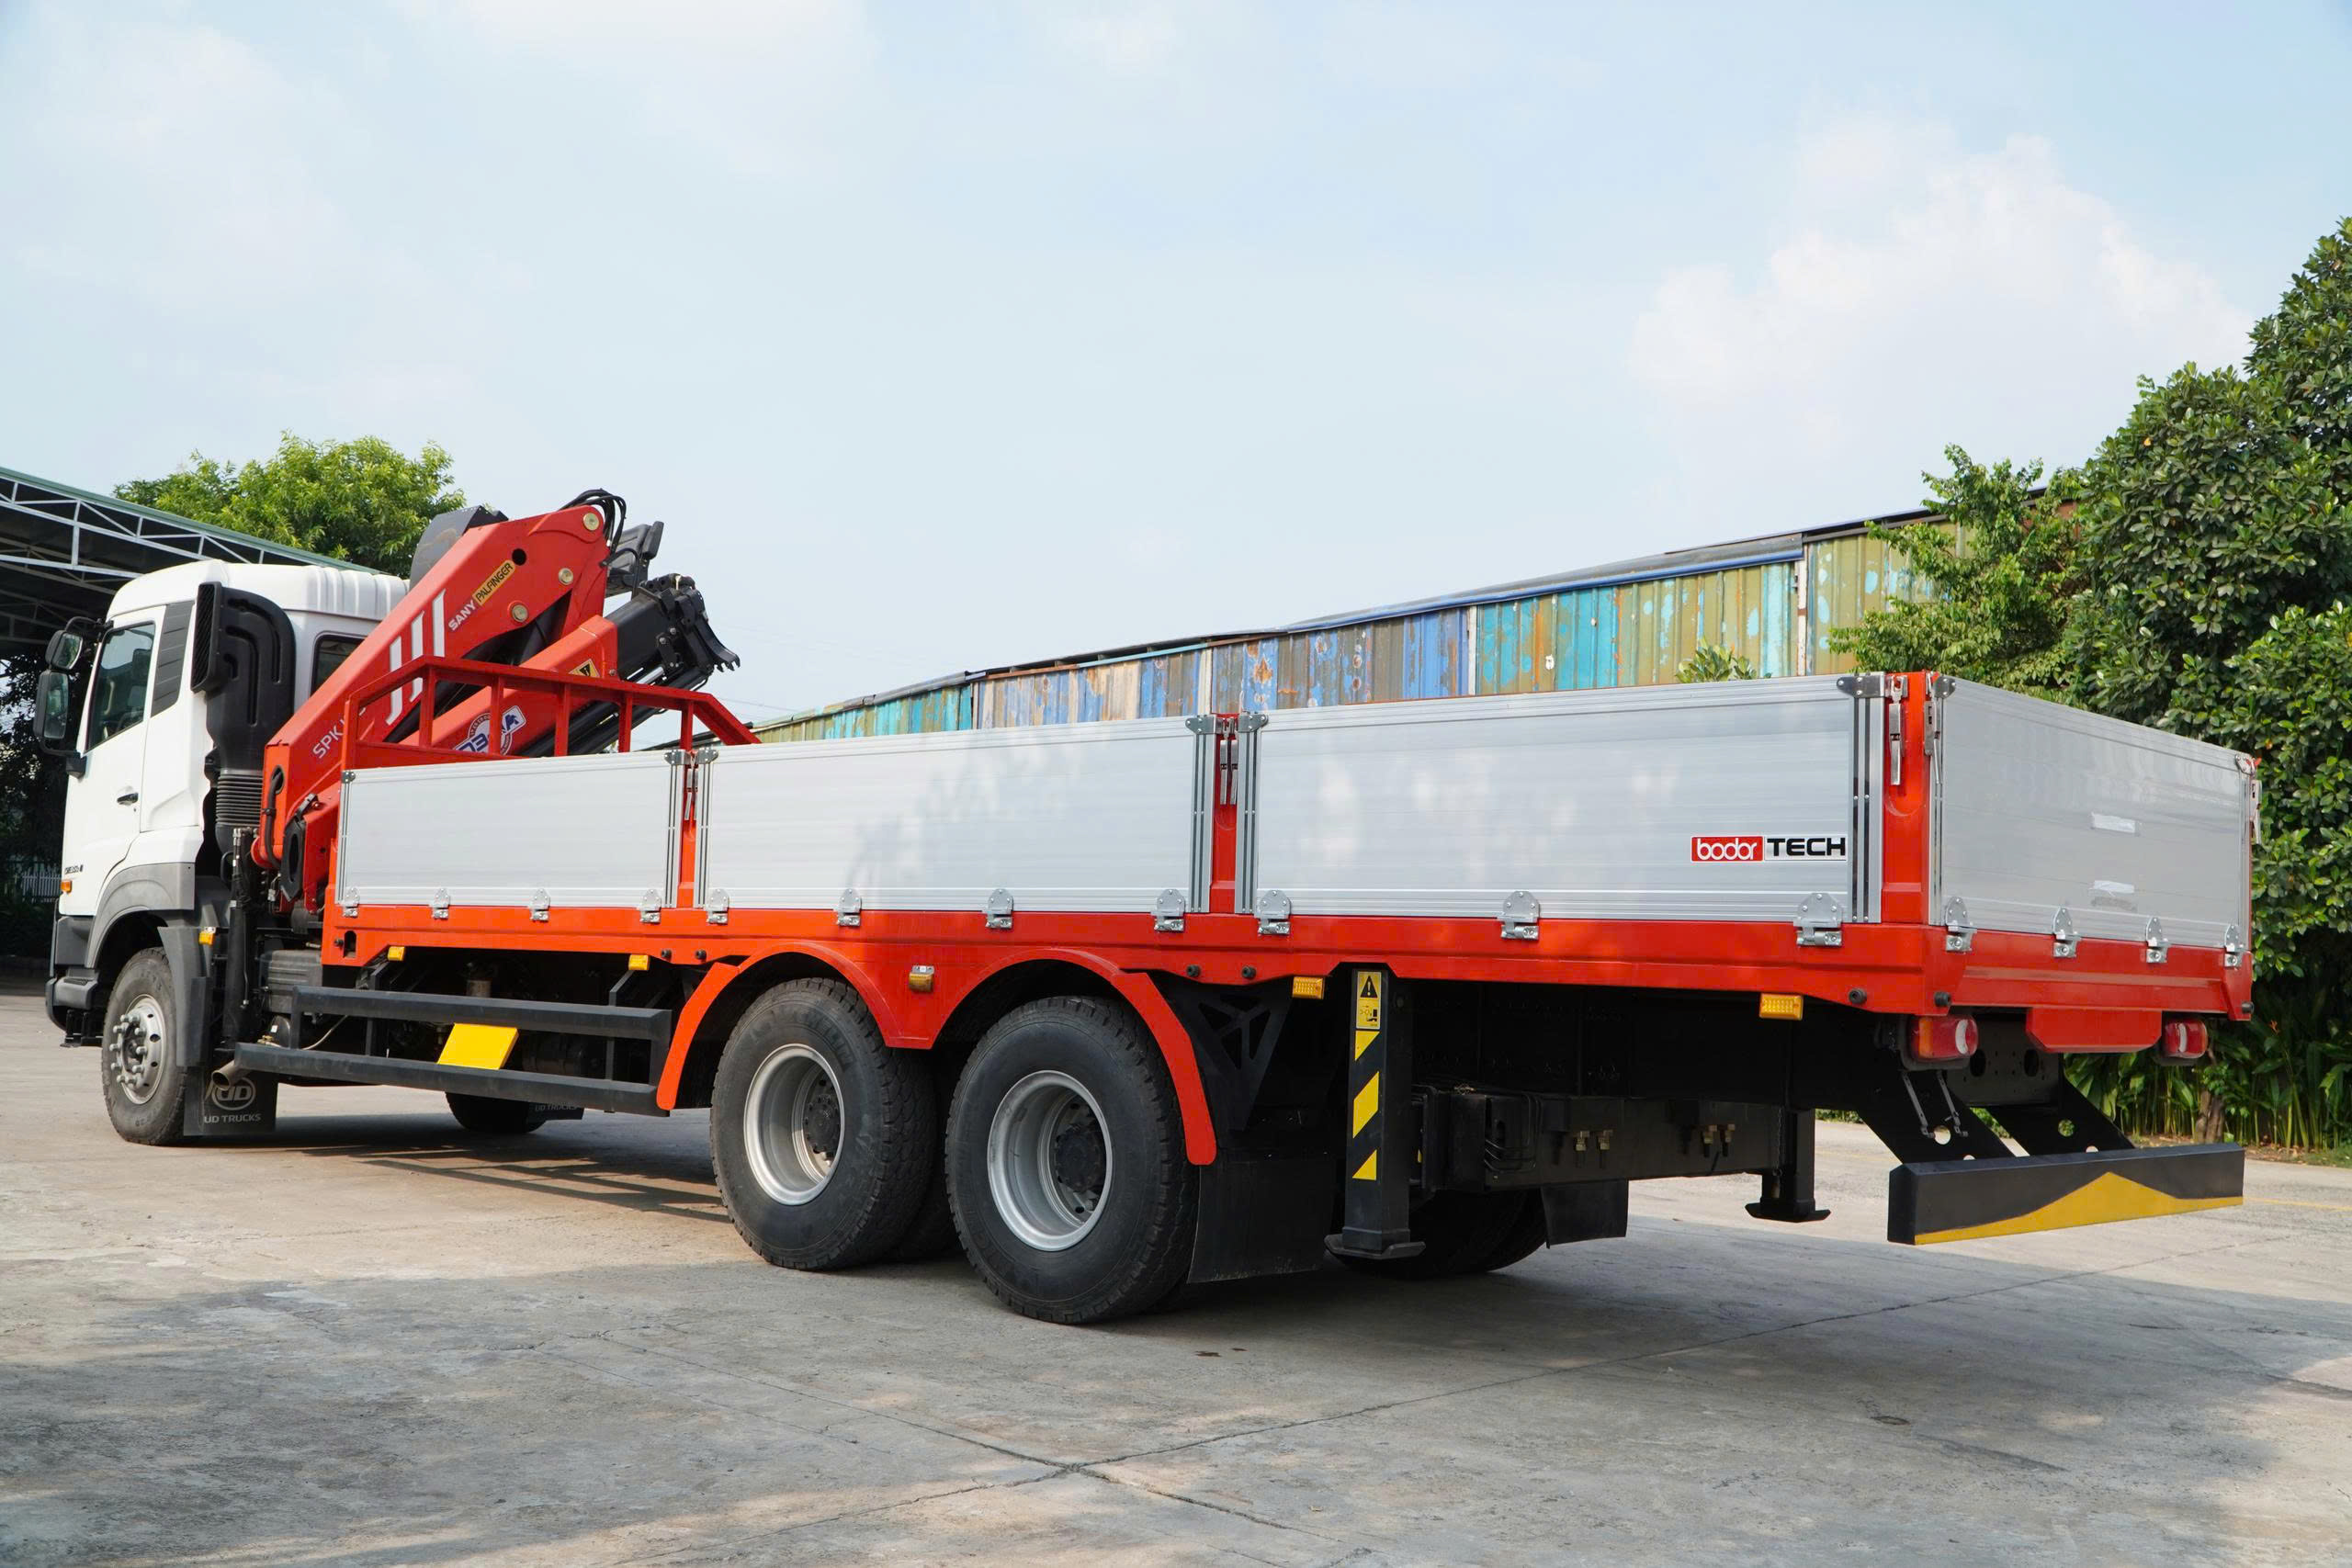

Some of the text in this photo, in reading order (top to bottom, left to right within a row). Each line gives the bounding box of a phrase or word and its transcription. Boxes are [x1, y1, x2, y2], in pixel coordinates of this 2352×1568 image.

[448, 562, 514, 631] SANY PALFINGER
[1697, 837, 1846, 860] bodor TECH
[204, 1113, 262, 1123] UD TRUCKS
